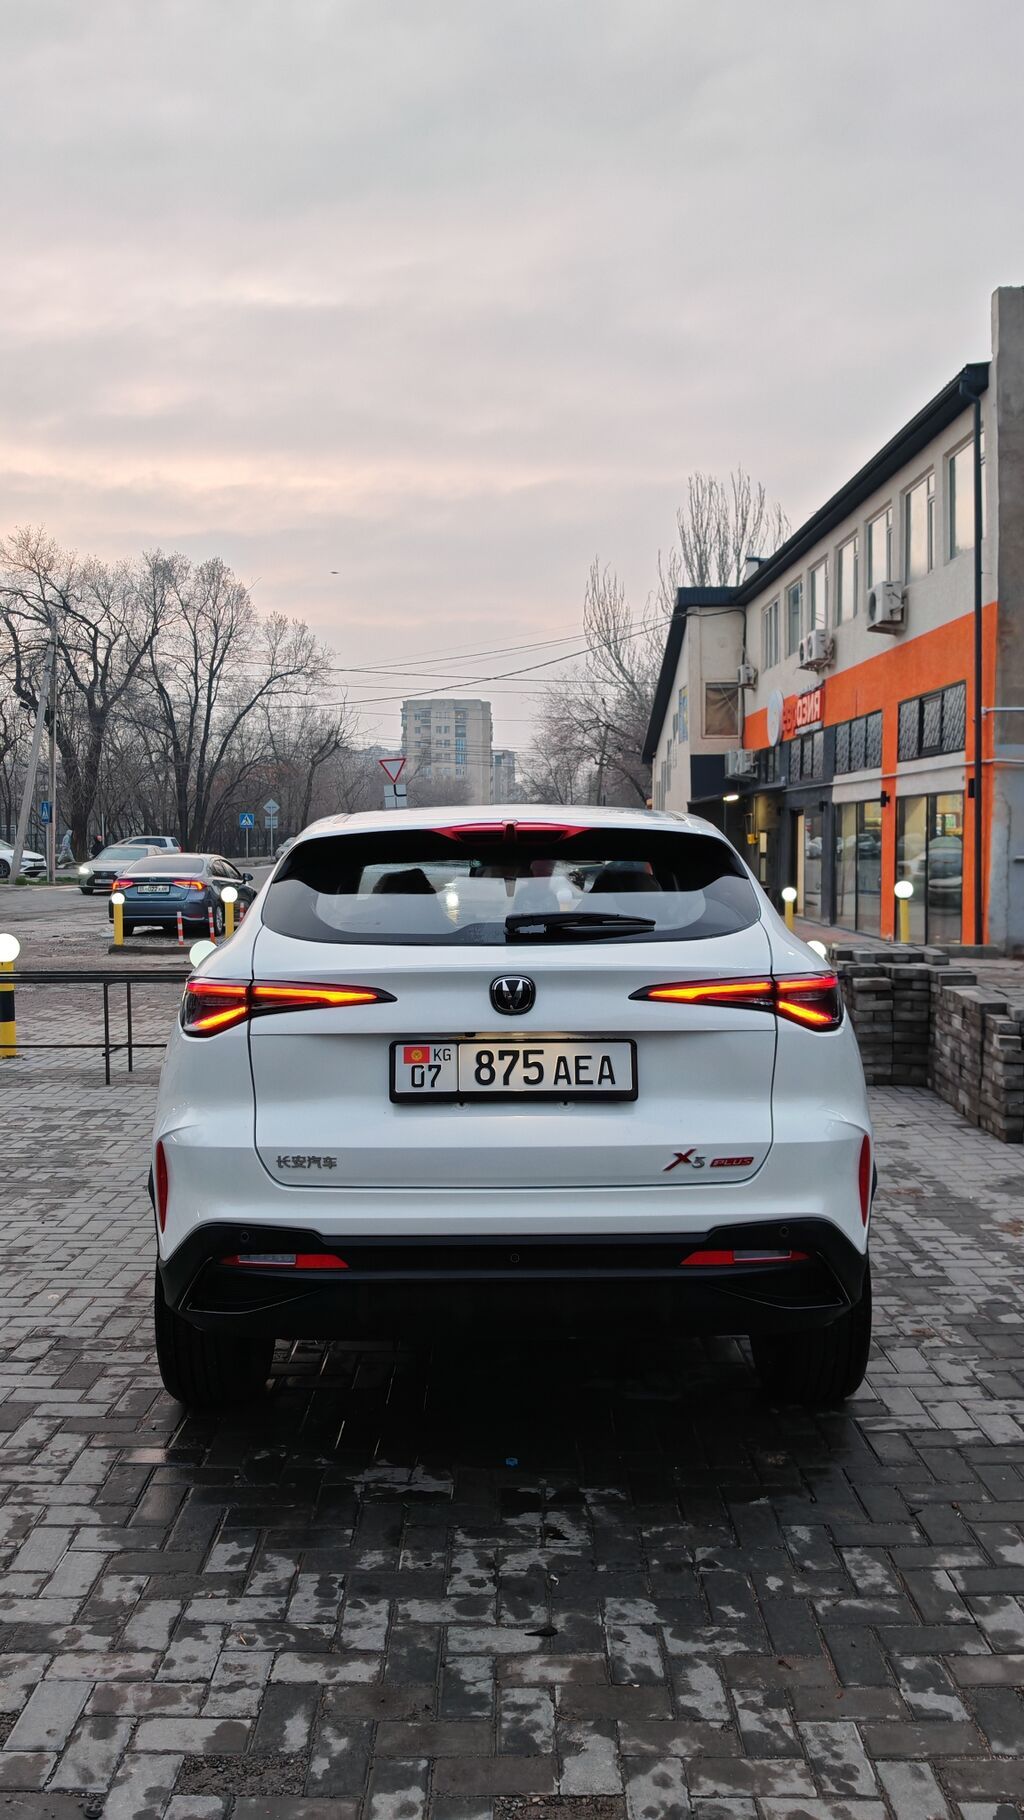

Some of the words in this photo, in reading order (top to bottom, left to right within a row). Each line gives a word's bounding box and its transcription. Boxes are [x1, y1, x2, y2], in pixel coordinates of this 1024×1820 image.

[433, 1048, 451, 1061] KG
[411, 1065, 442, 1088] 07
[474, 1049, 545, 1086] 875
[553, 1055, 616, 1085] AEA
[276, 1155, 337, 1169] 长安汽车
[663, 1148, 706, 1171] X5
[711, 1157, 753, 1167] PLUS
